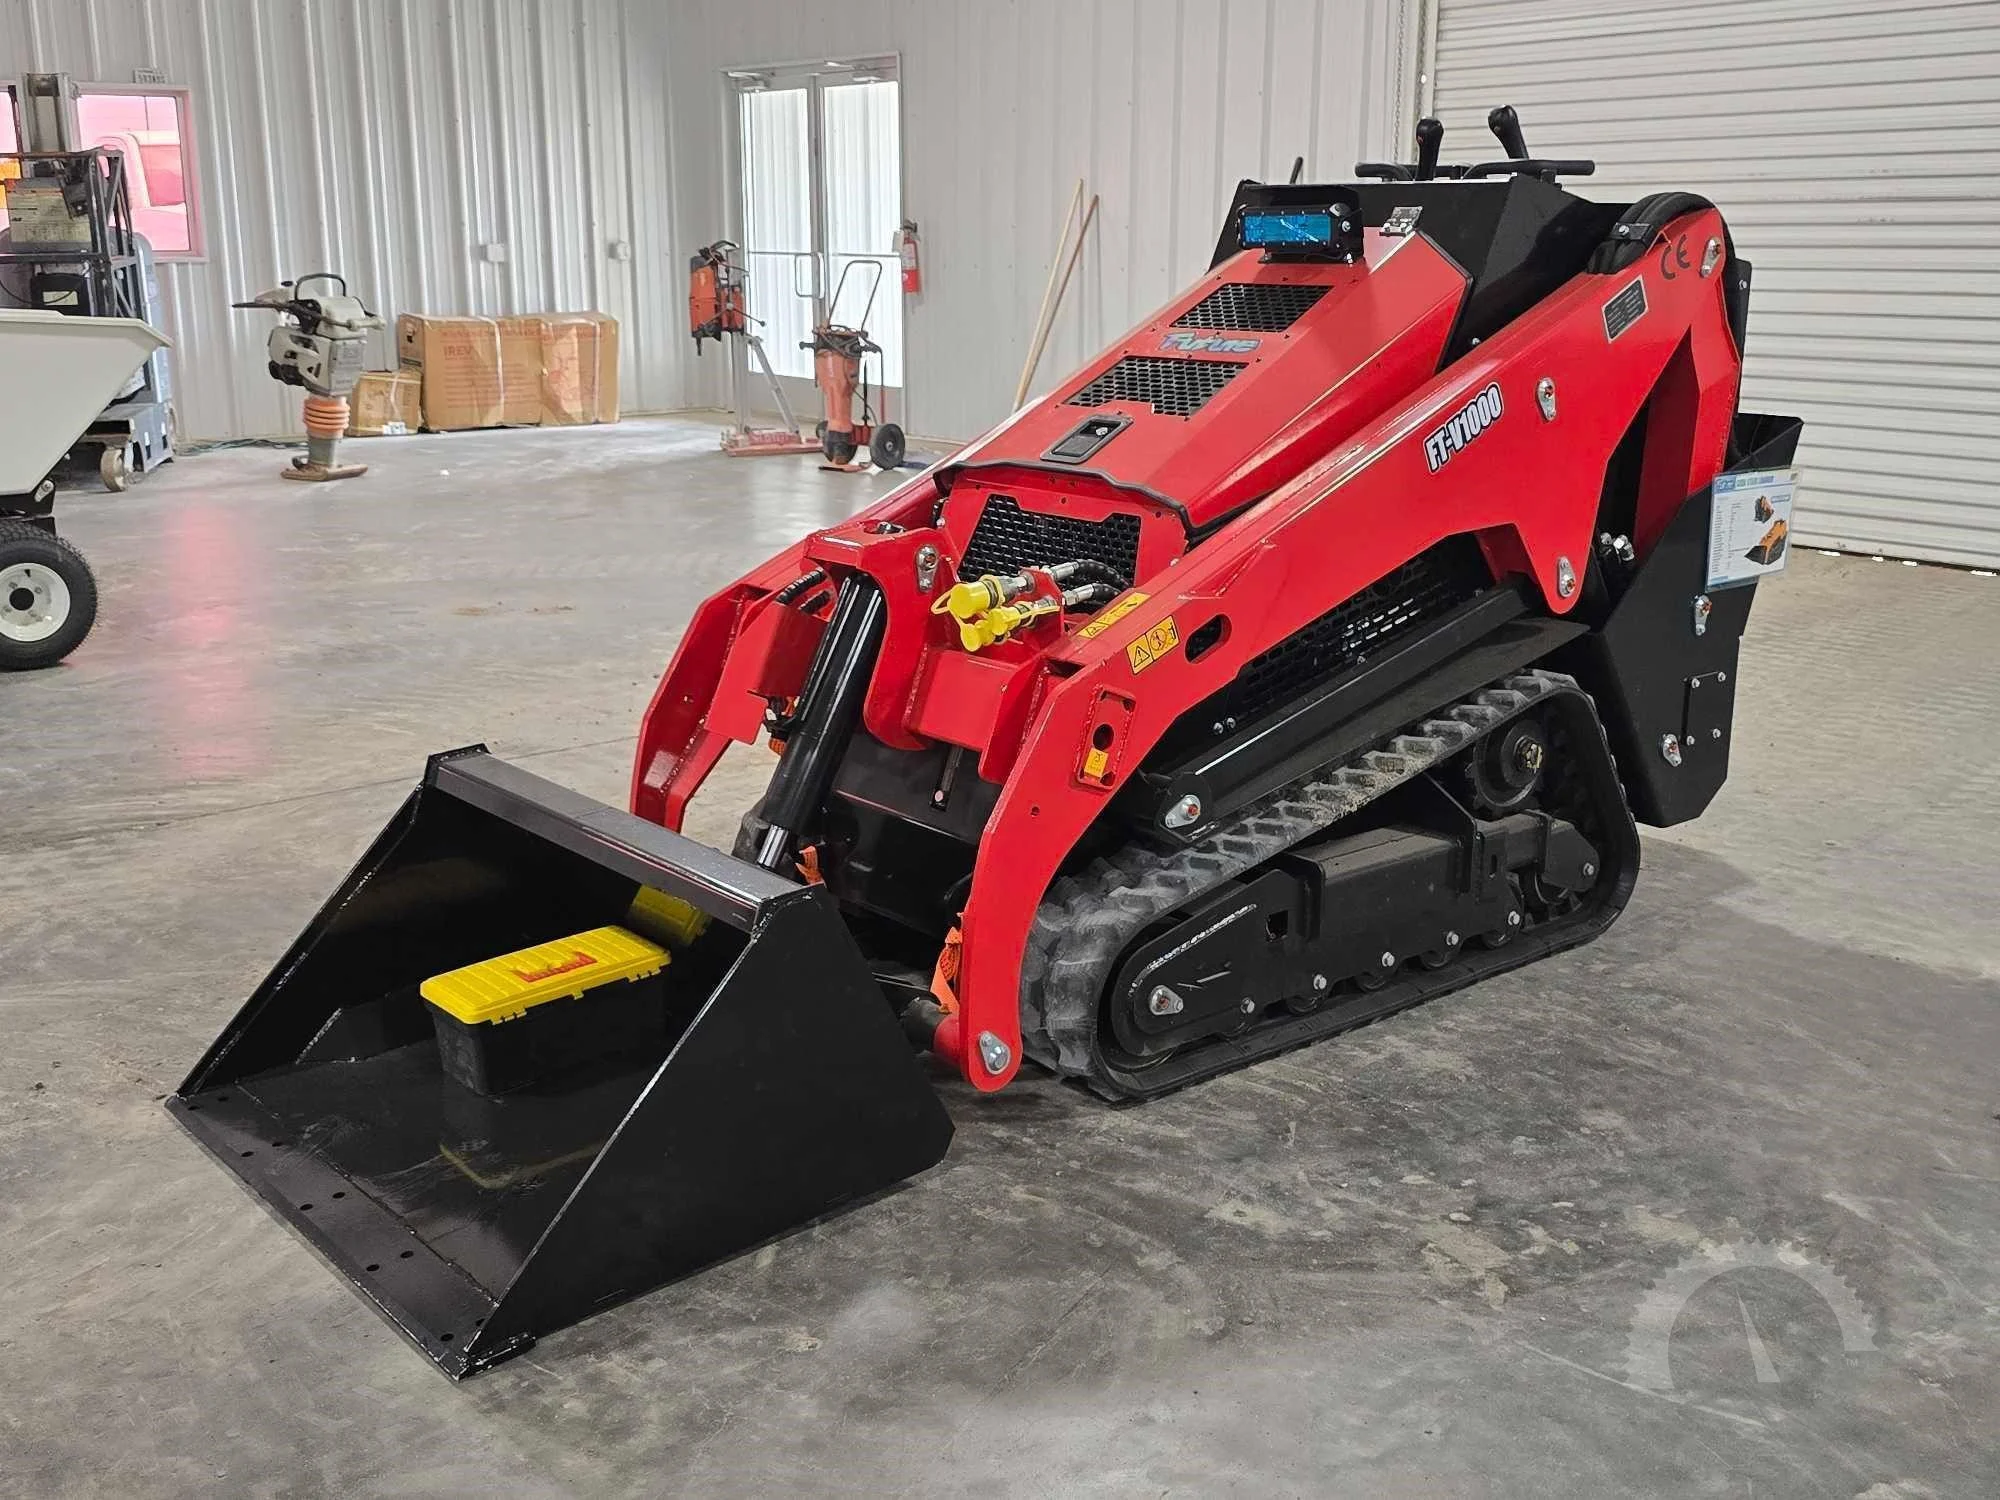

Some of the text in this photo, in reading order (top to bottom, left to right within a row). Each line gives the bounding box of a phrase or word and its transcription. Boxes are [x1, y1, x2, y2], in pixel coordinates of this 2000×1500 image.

[1661, 234, 1690, 280] CE
[1159, 332, 1260, 353] Future
[1424, 383, 1503, 473] FT-V1000
